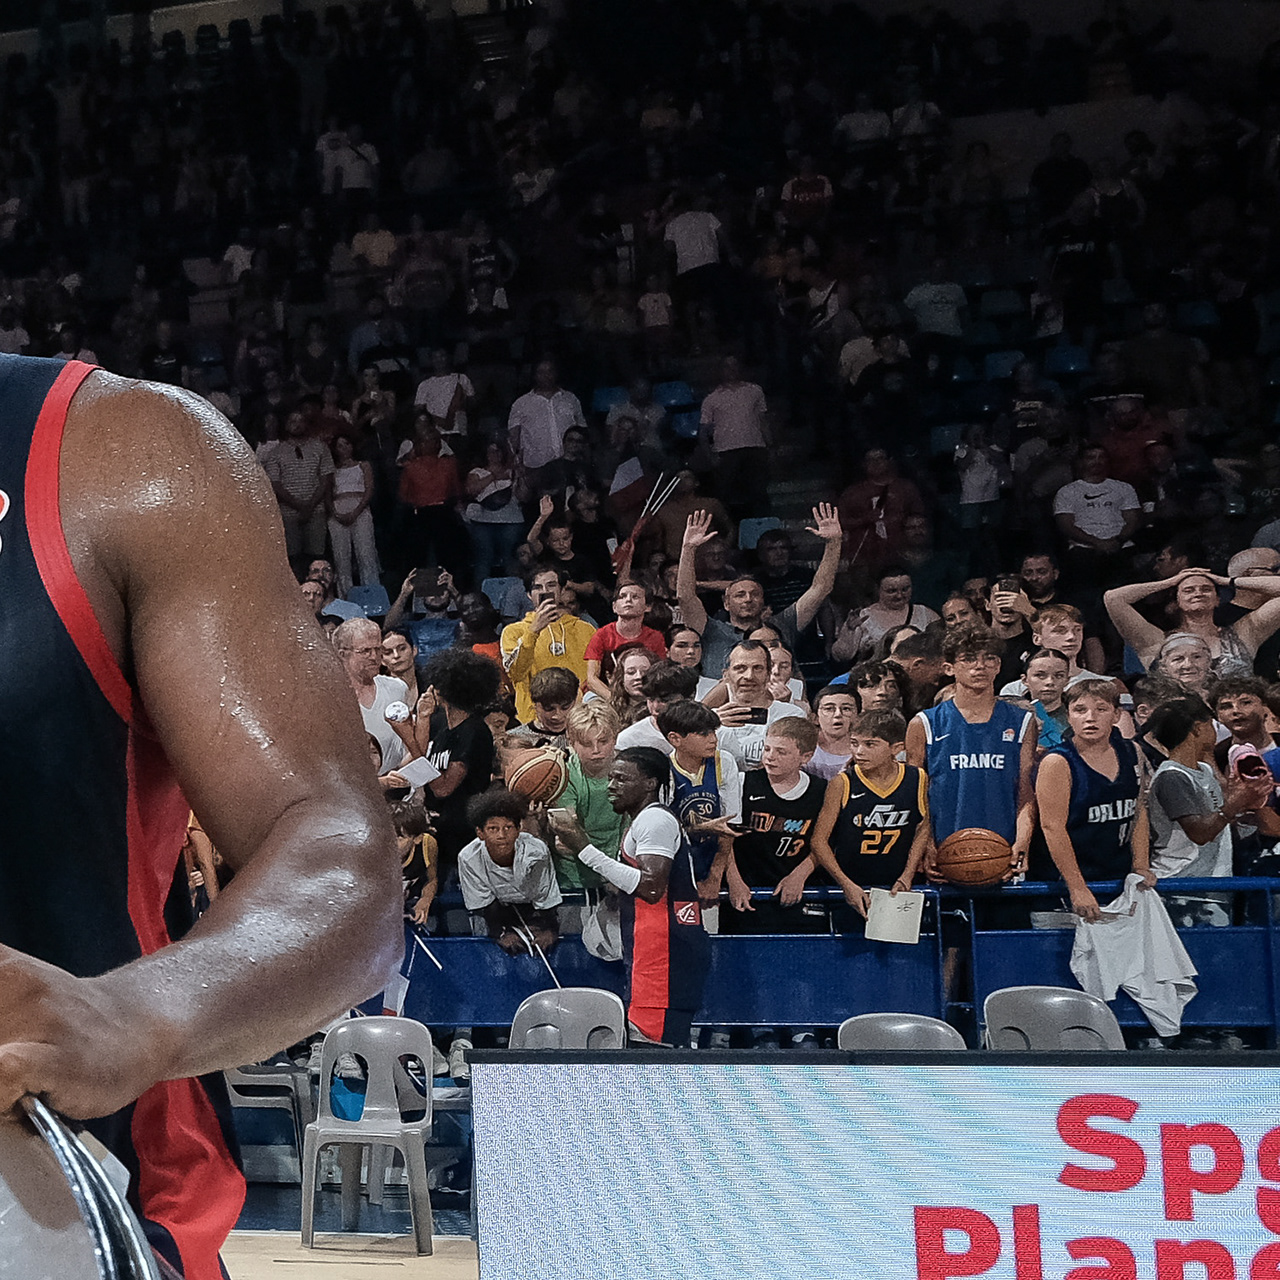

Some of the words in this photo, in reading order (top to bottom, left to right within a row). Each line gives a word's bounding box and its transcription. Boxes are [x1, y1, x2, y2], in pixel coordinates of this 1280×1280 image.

[949, 753, 1005, 770] FRANCE
[696, 802, 713, 816] 30
[864, 804, 911, 828] JAZZ
[775, 836, 806, 857] 13
[860, 829, 901, 855] 27
[1055, 1093, 1280, 1222] Sp
